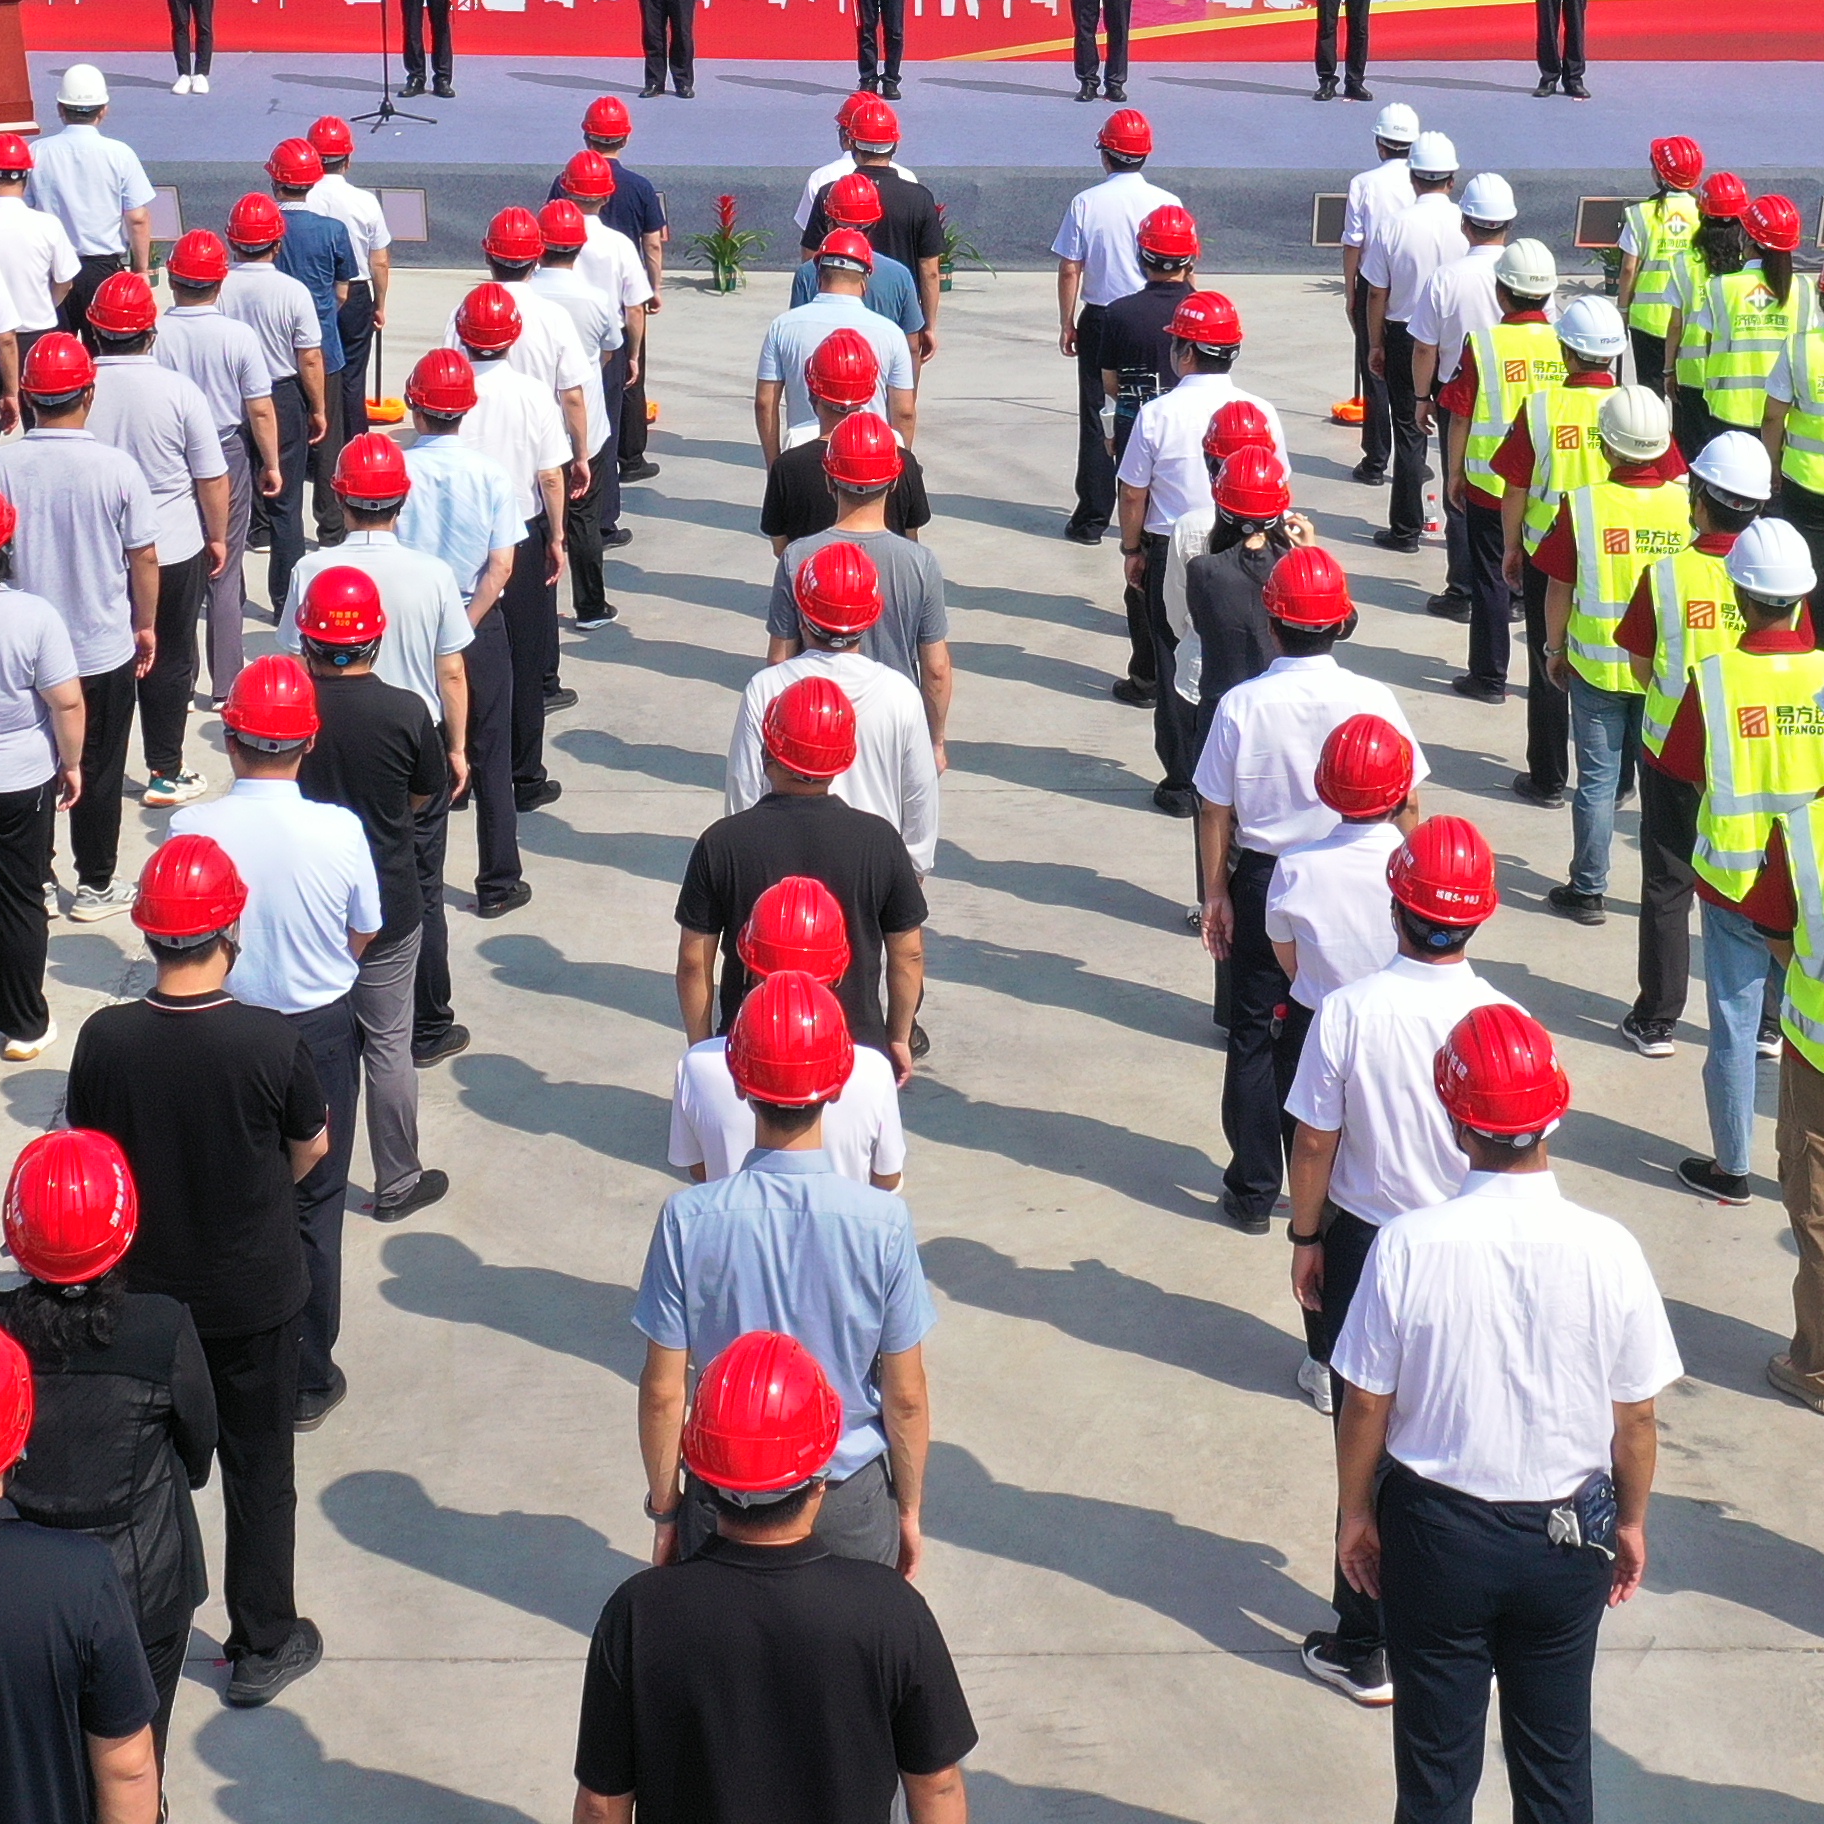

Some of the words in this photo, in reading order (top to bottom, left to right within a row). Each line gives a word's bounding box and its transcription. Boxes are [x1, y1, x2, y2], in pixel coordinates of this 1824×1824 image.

[1635, 529, 1682, 546] 易方达
[1635, 546, 1681, 556] YIFANGDA
